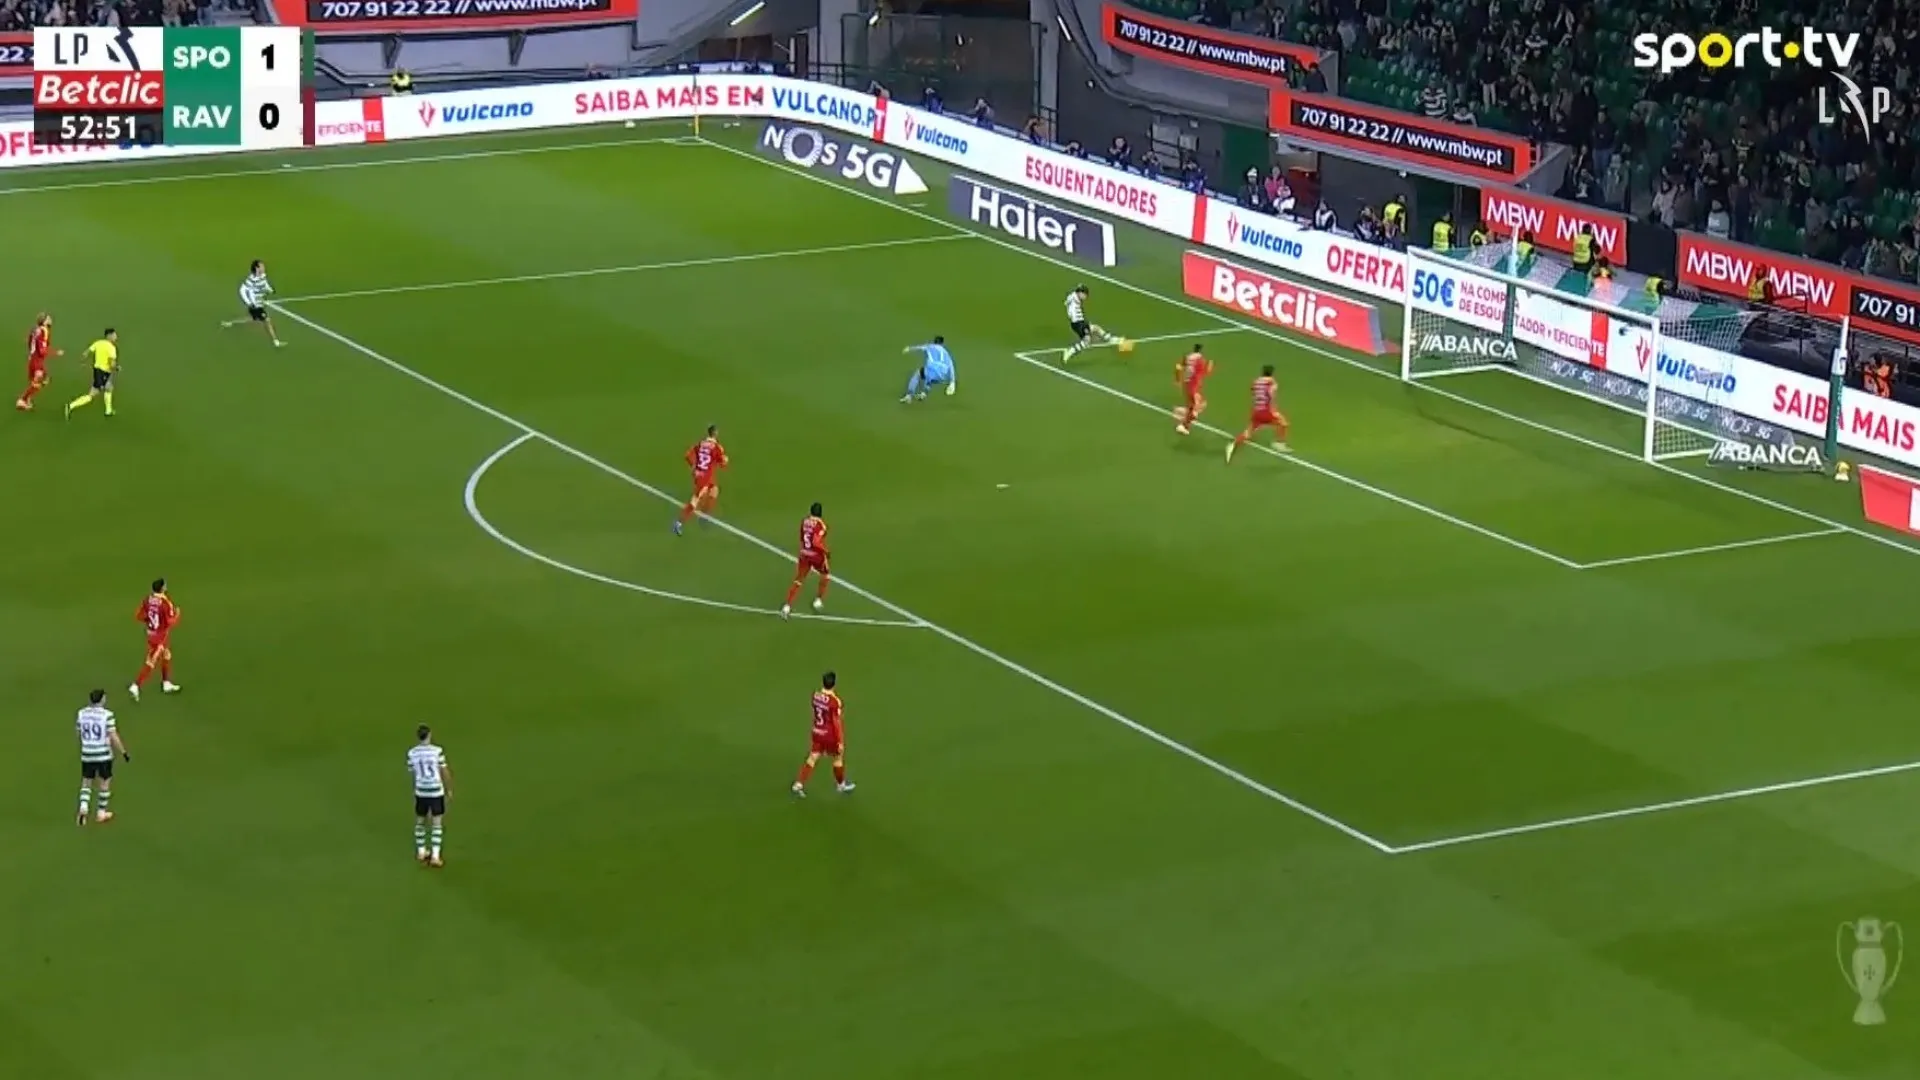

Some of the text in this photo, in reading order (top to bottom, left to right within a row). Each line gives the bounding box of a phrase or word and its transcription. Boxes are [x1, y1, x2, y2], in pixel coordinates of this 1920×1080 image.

[322, 1, 358, 18] 707
[365, 2, 386, 17] 91
[393, 0, 418, 16] 22
[424, 0, 450, 15] 22
[1120, 20, 1137, 37] 707
[1139, 27, 1151, 42] 91
[1152, 30, 1166, 47] 22
[1169, 35, 1184, 53] 22
[1199, 43, 1285, 74] www.mbw.pt
[442, 101, 534, 123] Vulcano
[575, 85, 886, 127] SAIBA MAIS EM VULCANO.PT
[916, 125, 968, 155] Vulcano
[1301, 106, 1327, 127] 707
[1329, 115, 1345, 132] 91
[1347, 119, 1367, 137] 22
[1369, 123, 1389, 142] 22
[1406, 131, 1503, 166] www.mbw.pt
[842, 144, 895, 188] 5G
[1025, 155, 1158, 217] ESQUENTADORES
[970, 185, 1077, 253] Haier
[1487, 196, 1545, 234] MBW
[1241, 224, 1303, 259] Vulcano
[1326, 245, 1405, 292] OFERTA
[1687, 247, 1753, 287] MBW
[1212, 266, 1339, 338] Betclic
[1412, 268, 1456, 308] 50€
[1460, 281, 1475, 297] NA
[1459, 298, 1472, 314] DE
[1858, 292, 1916, 325] 707 91
[1773, 383, 1845, 432] SAIB
[1852, 407, 1915, 452] MAIS
[82, 723, 102, 741] 89
[816, 706, 824, 726] 3
[418, 759, 434, 778] 13
